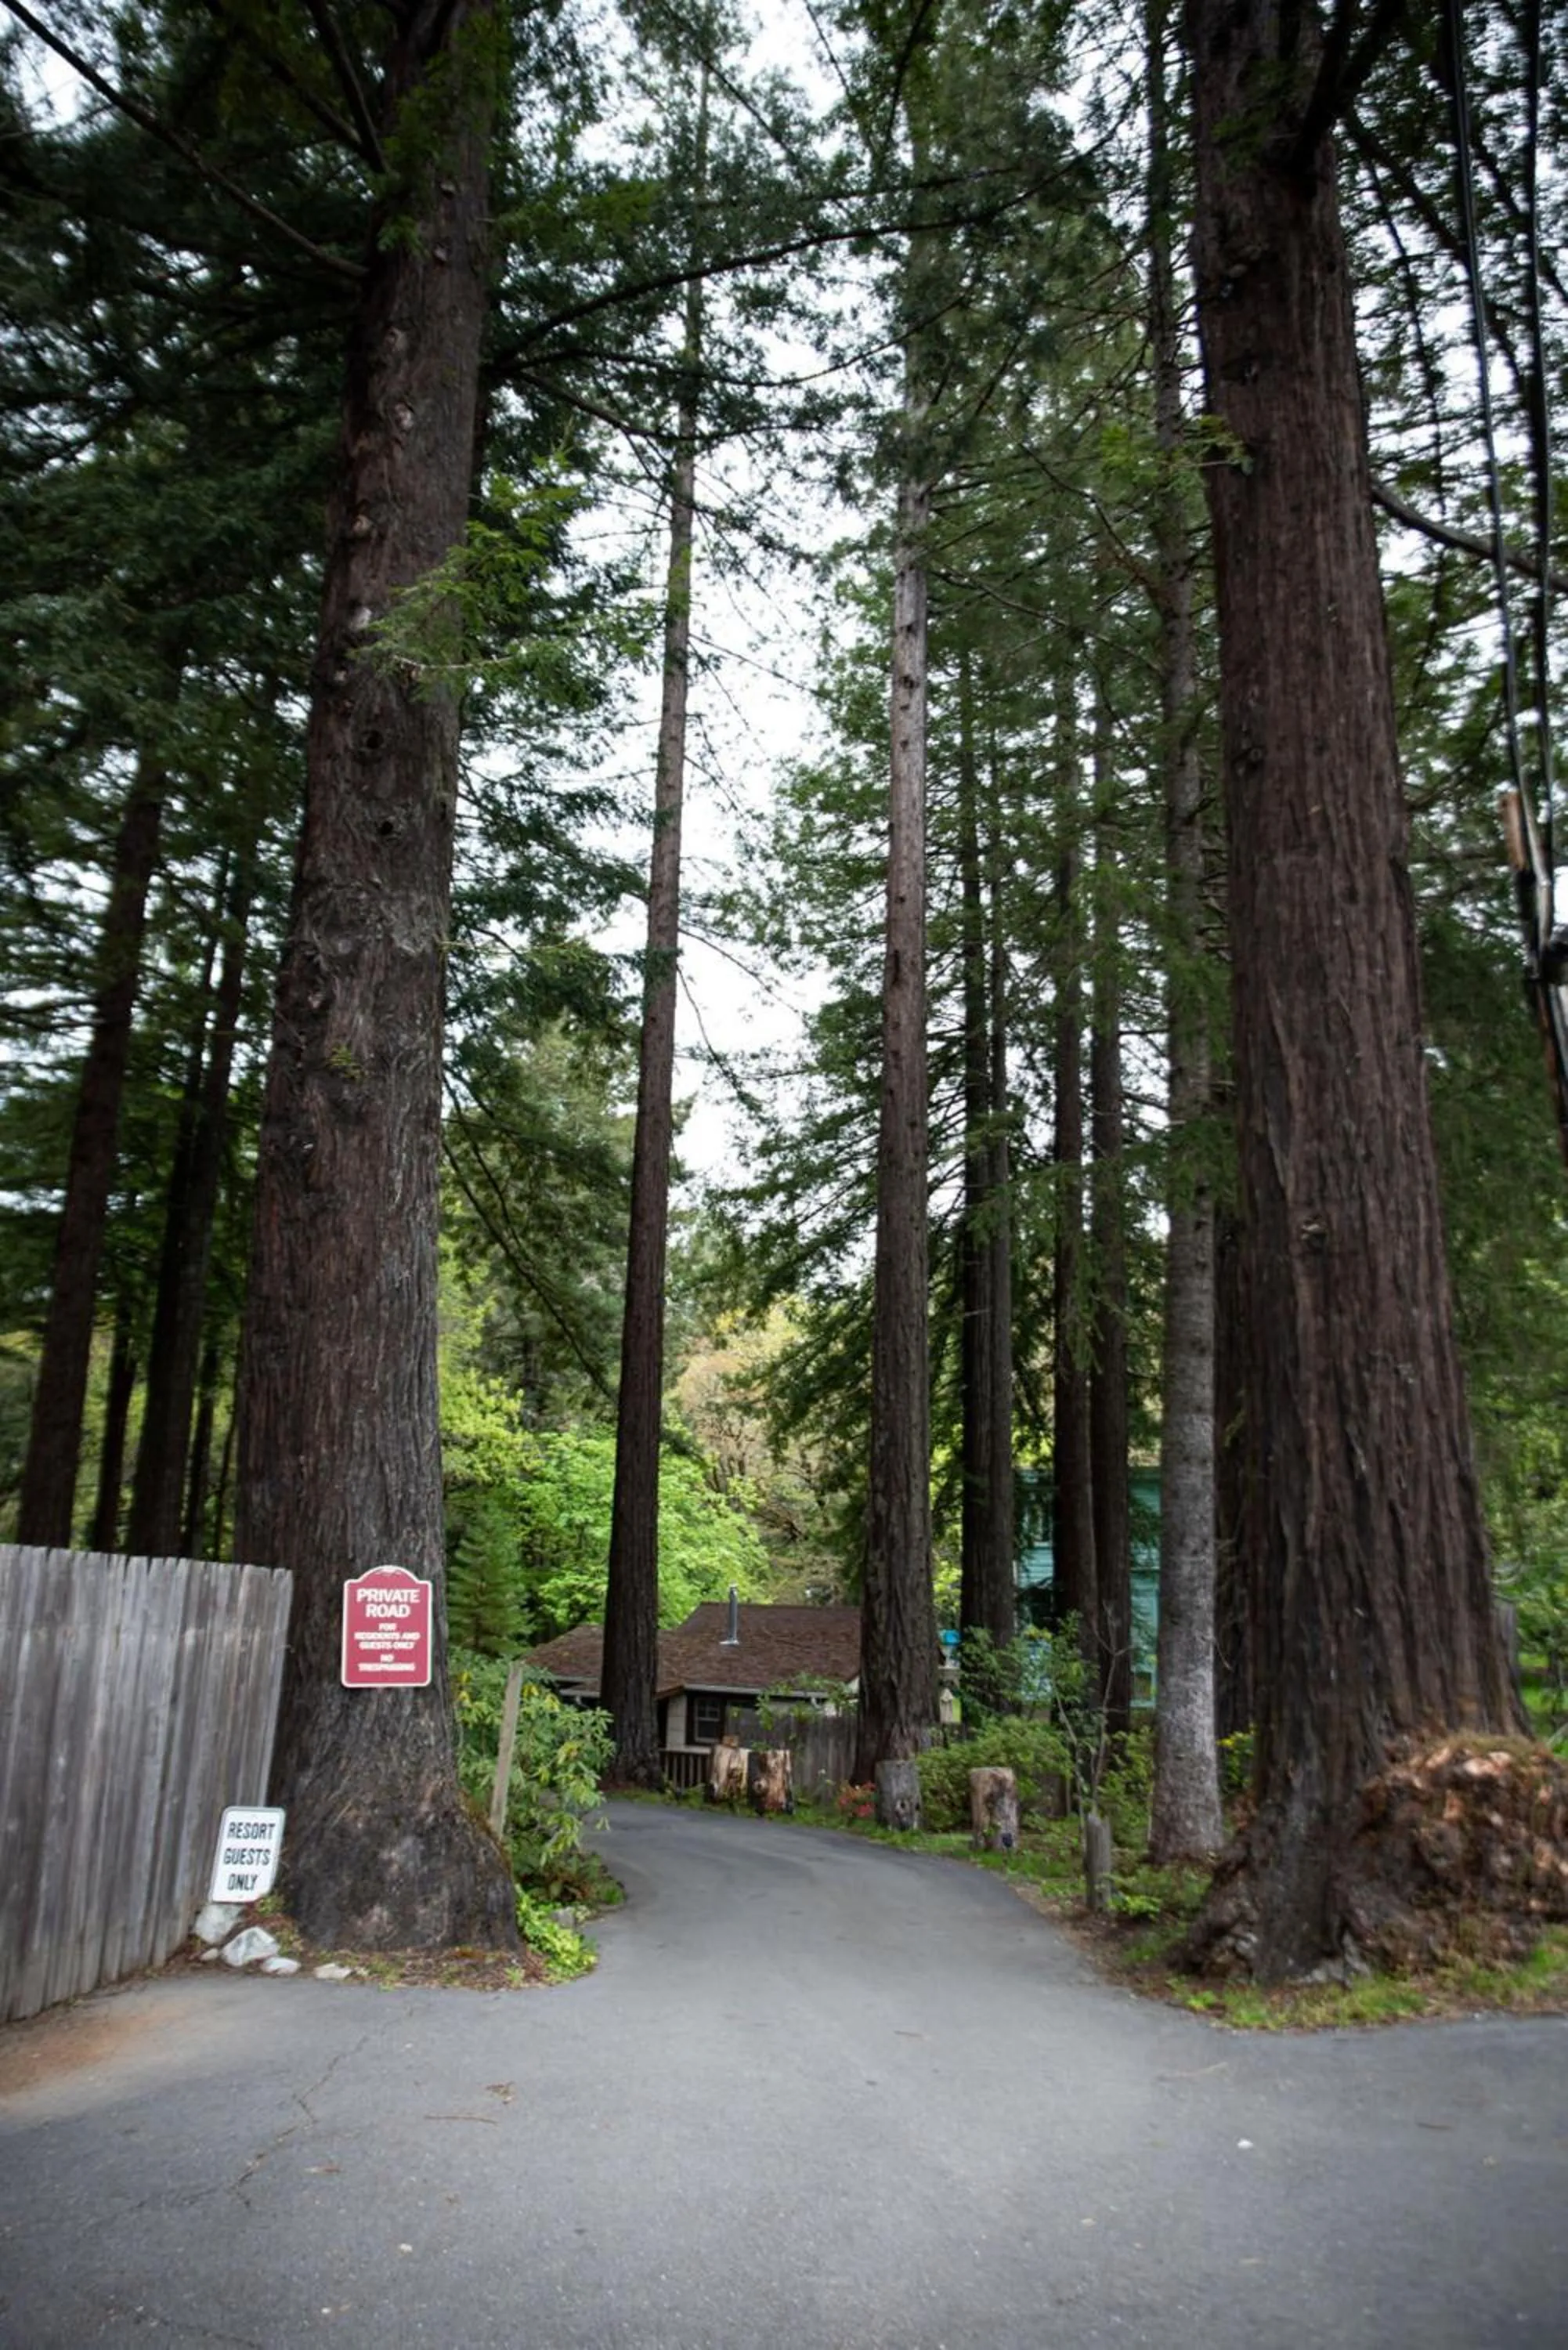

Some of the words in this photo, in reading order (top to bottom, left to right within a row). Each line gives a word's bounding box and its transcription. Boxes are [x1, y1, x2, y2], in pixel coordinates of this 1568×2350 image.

[356, 1589, 421, 1603] PRIVATE
[366, 1604, 410, 1618] ROAD
[227, 1822, 276, 1839] RESORT
[224, 1848, 270, 1865] GUESTS
[228, 1874, 258, 1890] ONLY
